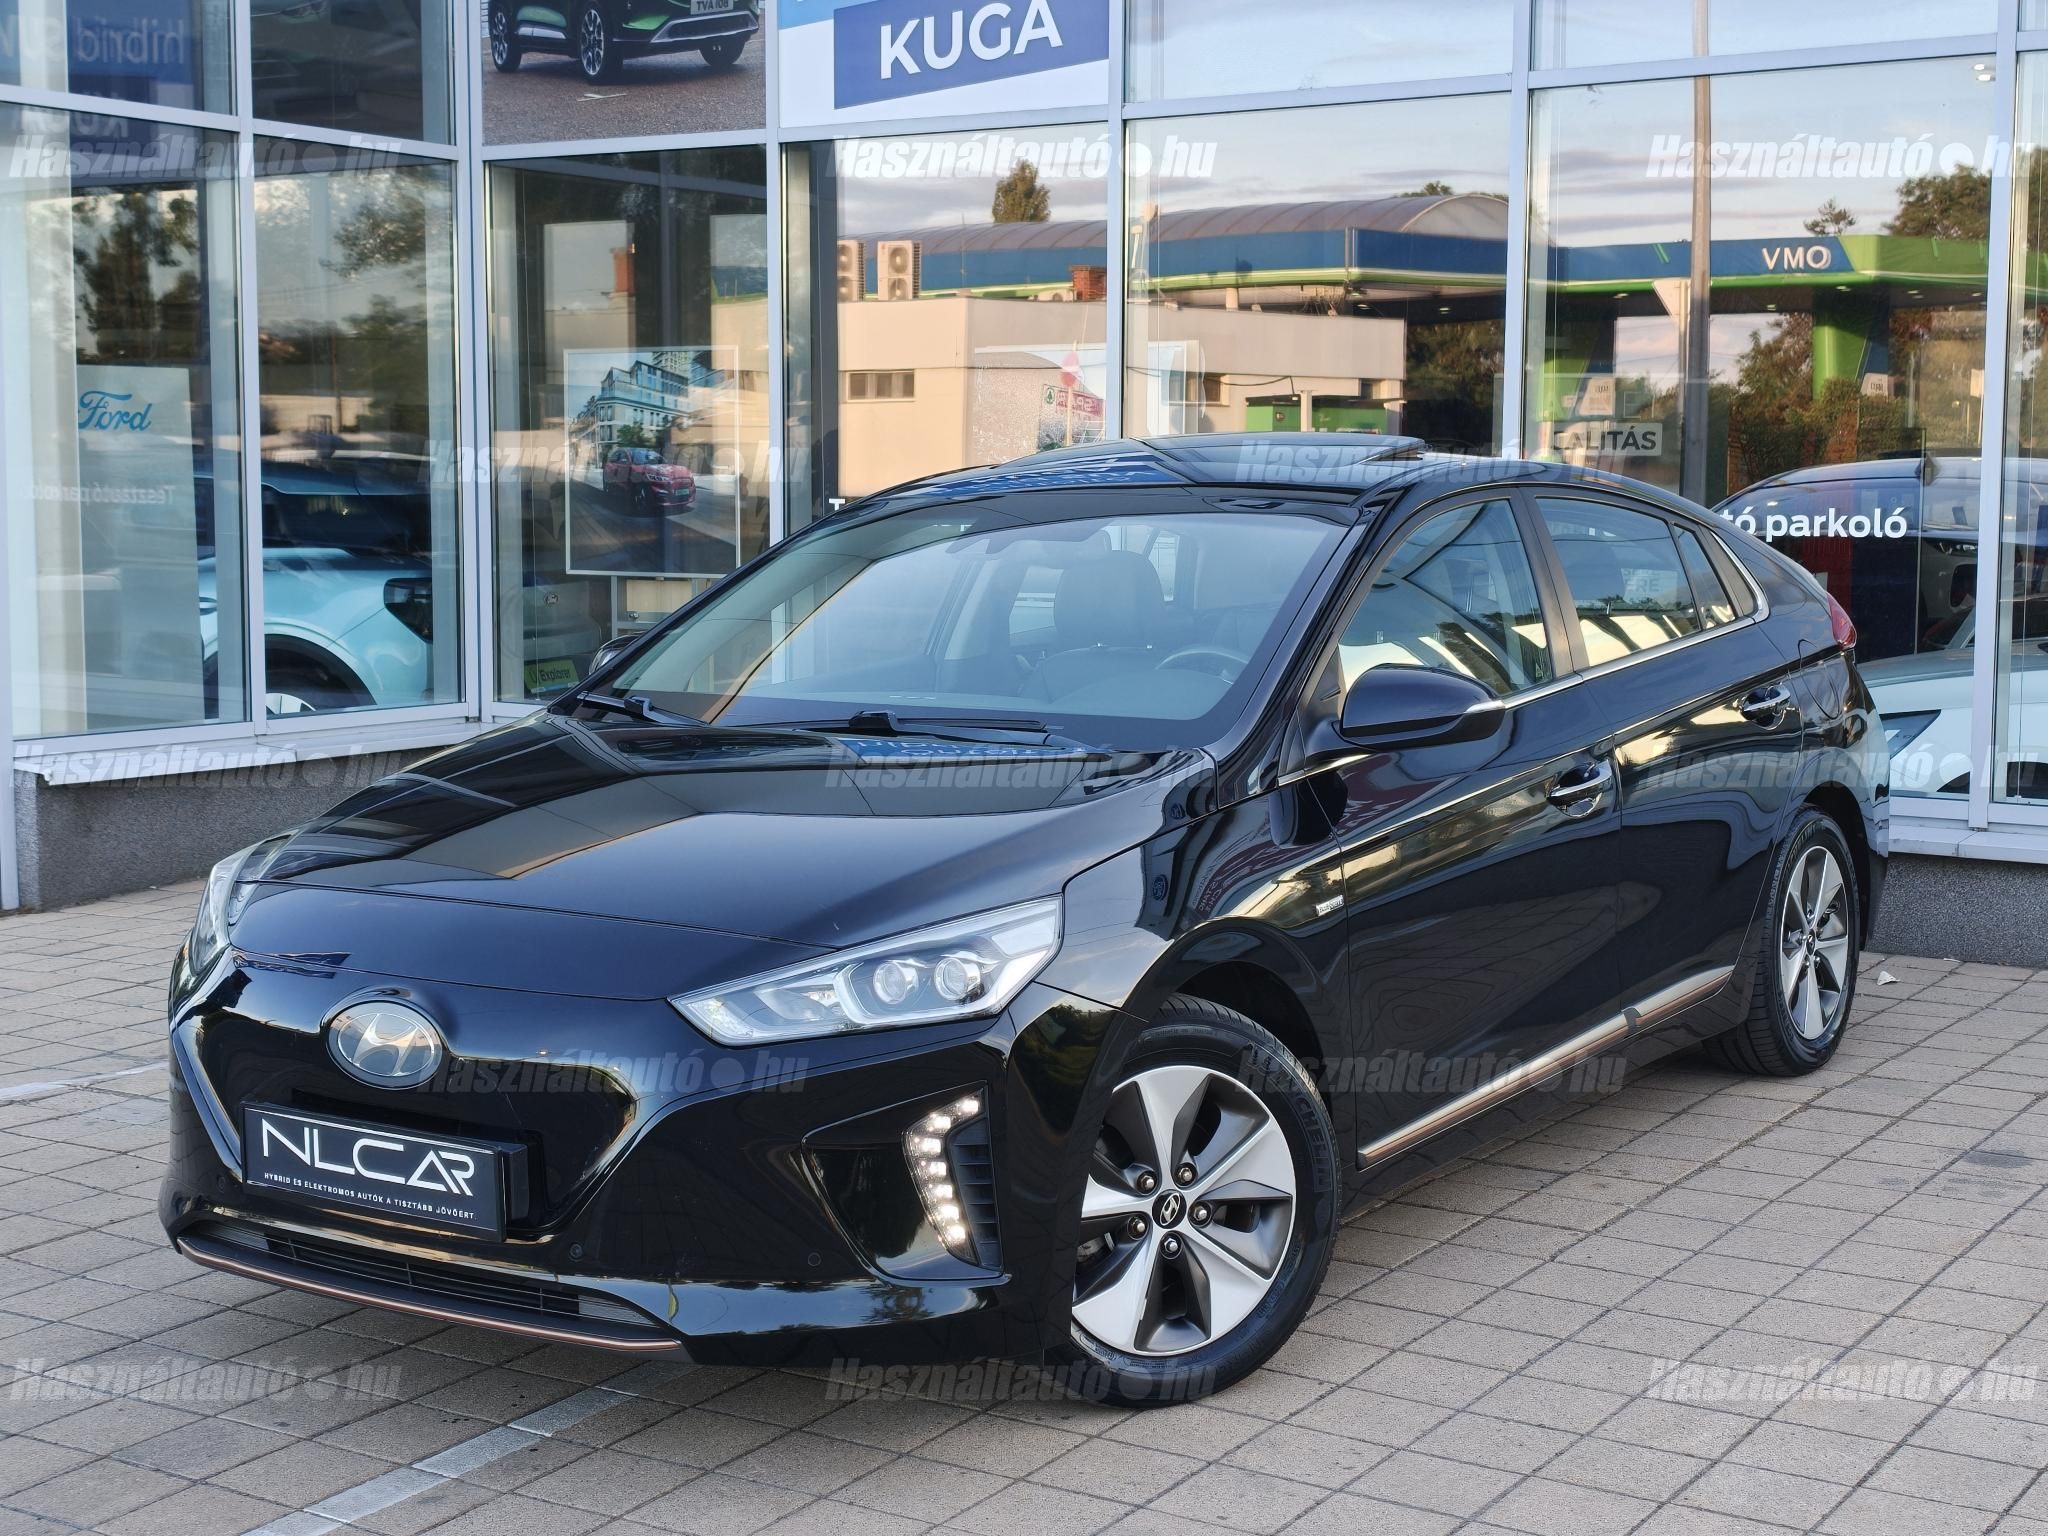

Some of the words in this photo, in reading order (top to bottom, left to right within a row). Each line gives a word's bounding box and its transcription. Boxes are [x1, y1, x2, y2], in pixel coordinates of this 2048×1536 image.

[880, 0, 1063, 80] KUGA
[78, 390, 153, 432] Ford
[1766, 507, 1908, 542] parkoló
[261, 1118, 475, 1197] NLCAR
[263, 1172, 291, 1185] HYBRID
[304, 1180, 355, 1198] ELEKTROMOS
[357, 1189, 384, 1204] AUTÓK
[386, 1196, 391, 1205] A
[393, 1198, 433, 1213] TISZTÁBB
